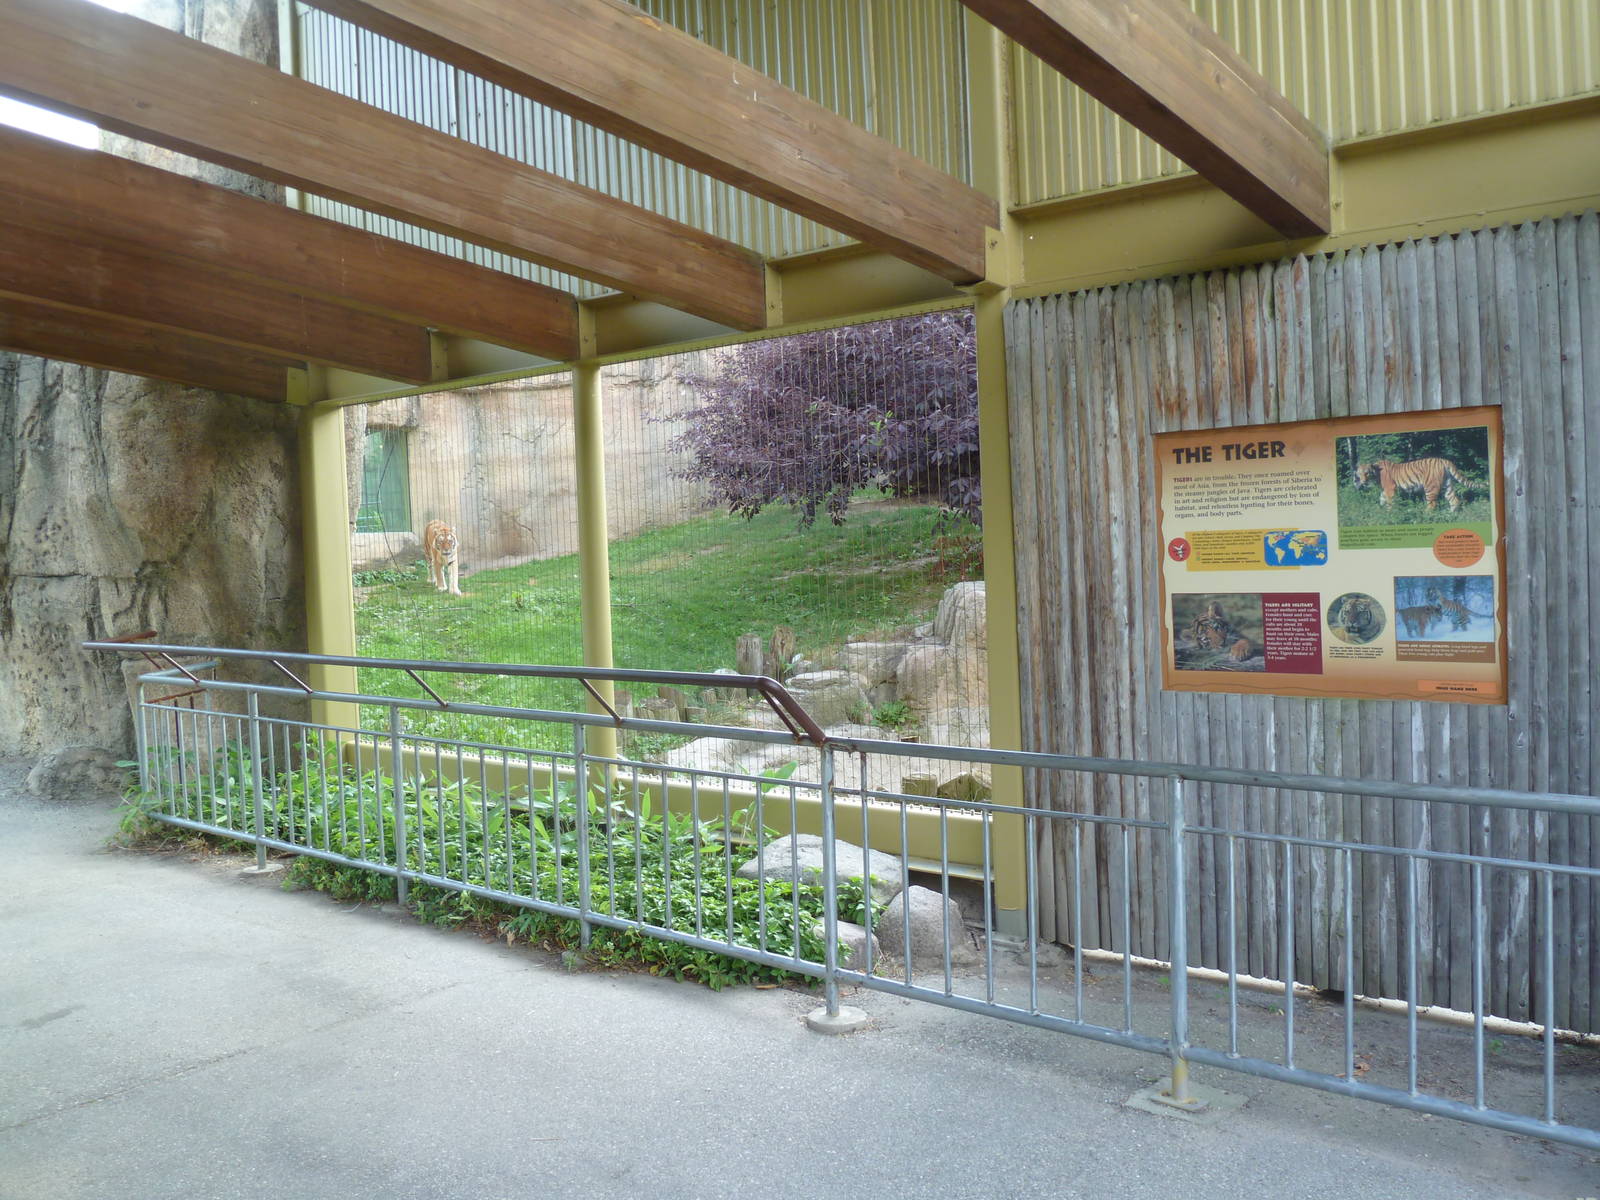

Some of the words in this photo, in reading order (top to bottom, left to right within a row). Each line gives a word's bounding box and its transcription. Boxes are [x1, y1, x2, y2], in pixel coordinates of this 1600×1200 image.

[1173, 446, 1212, 464] THE
[1222, 440, 1286, 461] TIGER
[1240, 501, 1265, 509] hunting
